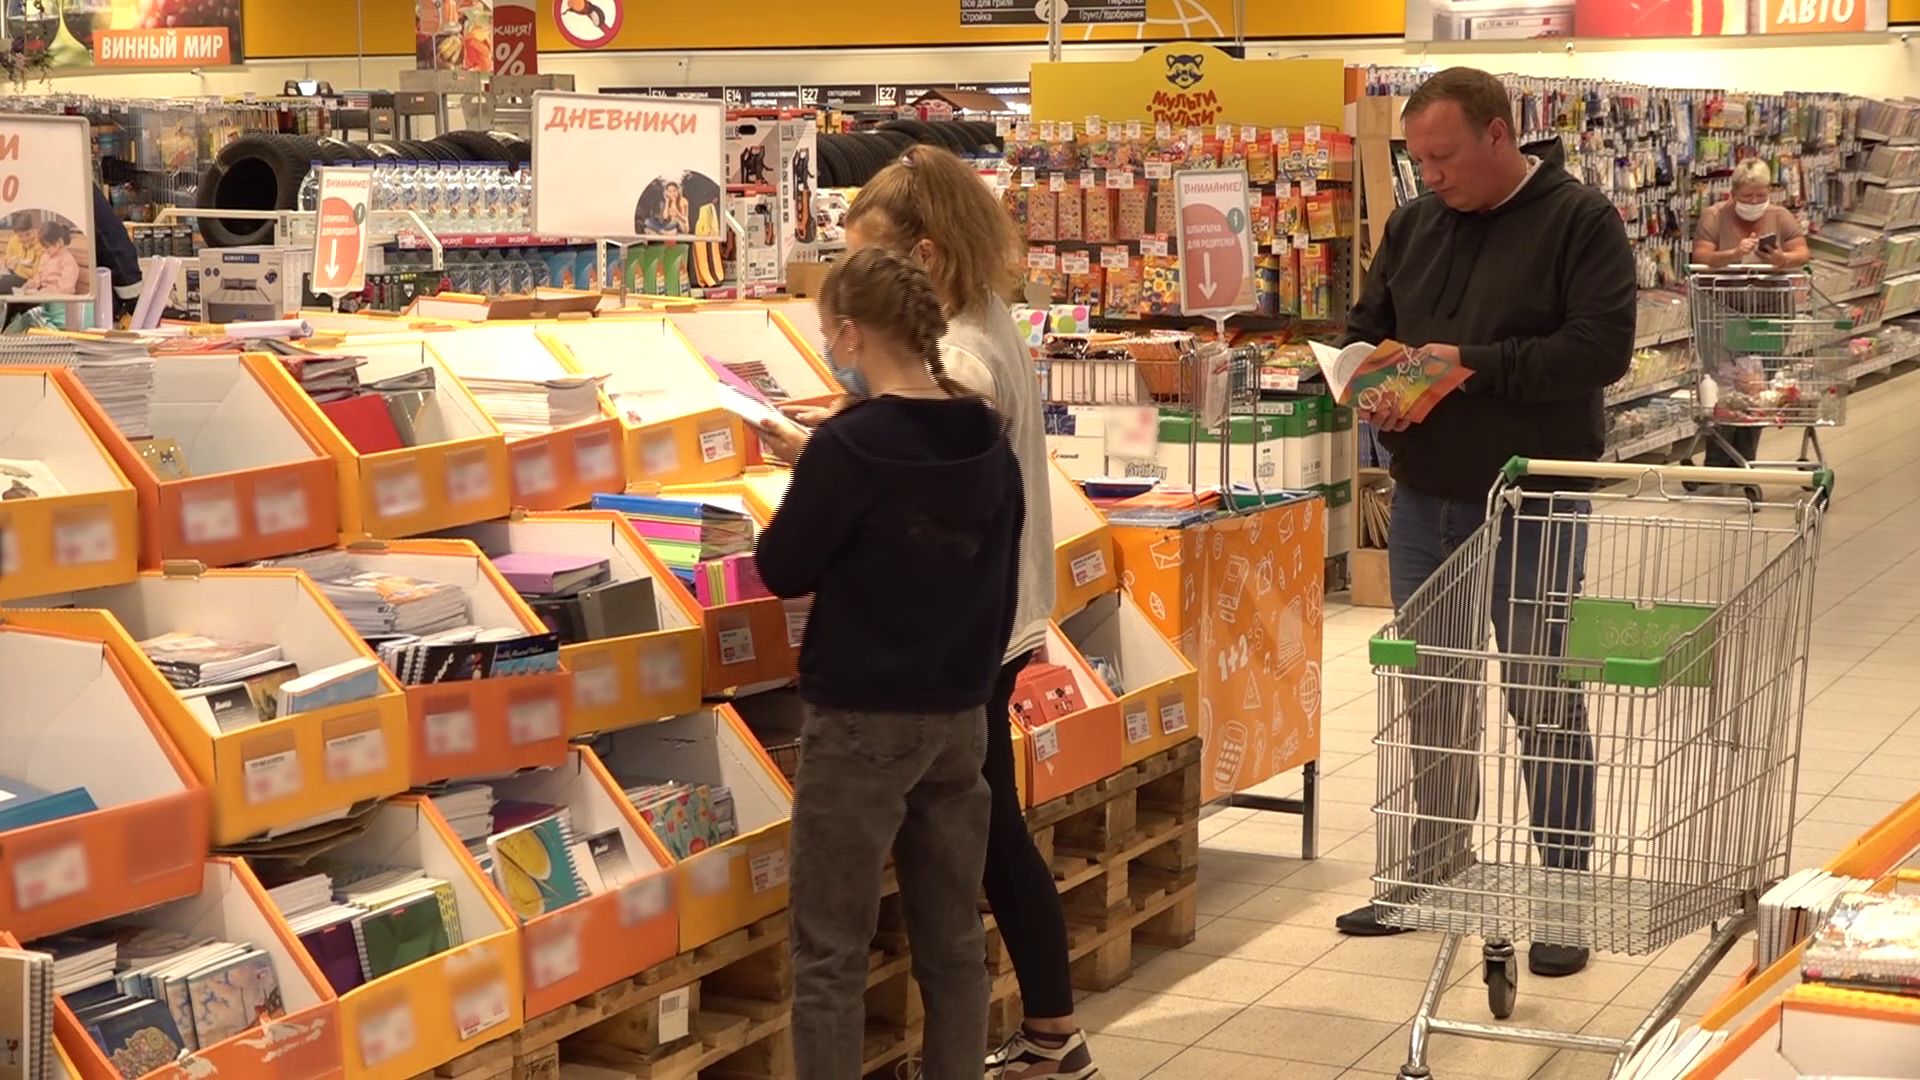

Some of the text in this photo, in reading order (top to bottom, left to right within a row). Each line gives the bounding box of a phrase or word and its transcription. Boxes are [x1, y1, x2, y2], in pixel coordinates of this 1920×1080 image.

[494, 22, 532, 37] кция!
[101, 30, 223, 59] ВИННЫЙ МИР
[726, 89, 742, 102] E14
[802, 88, 819, 101] E27
[879, 87, 896, 100] E27
[1152, 89, 1217, 111] МУЛЬТИ
[544, 106, 697, 135] ДНЕВНИКИ
[1183, 182, 1242, 194] ВНИМАНИЕ!
[1218, 634, 1249, 682] 1+2
